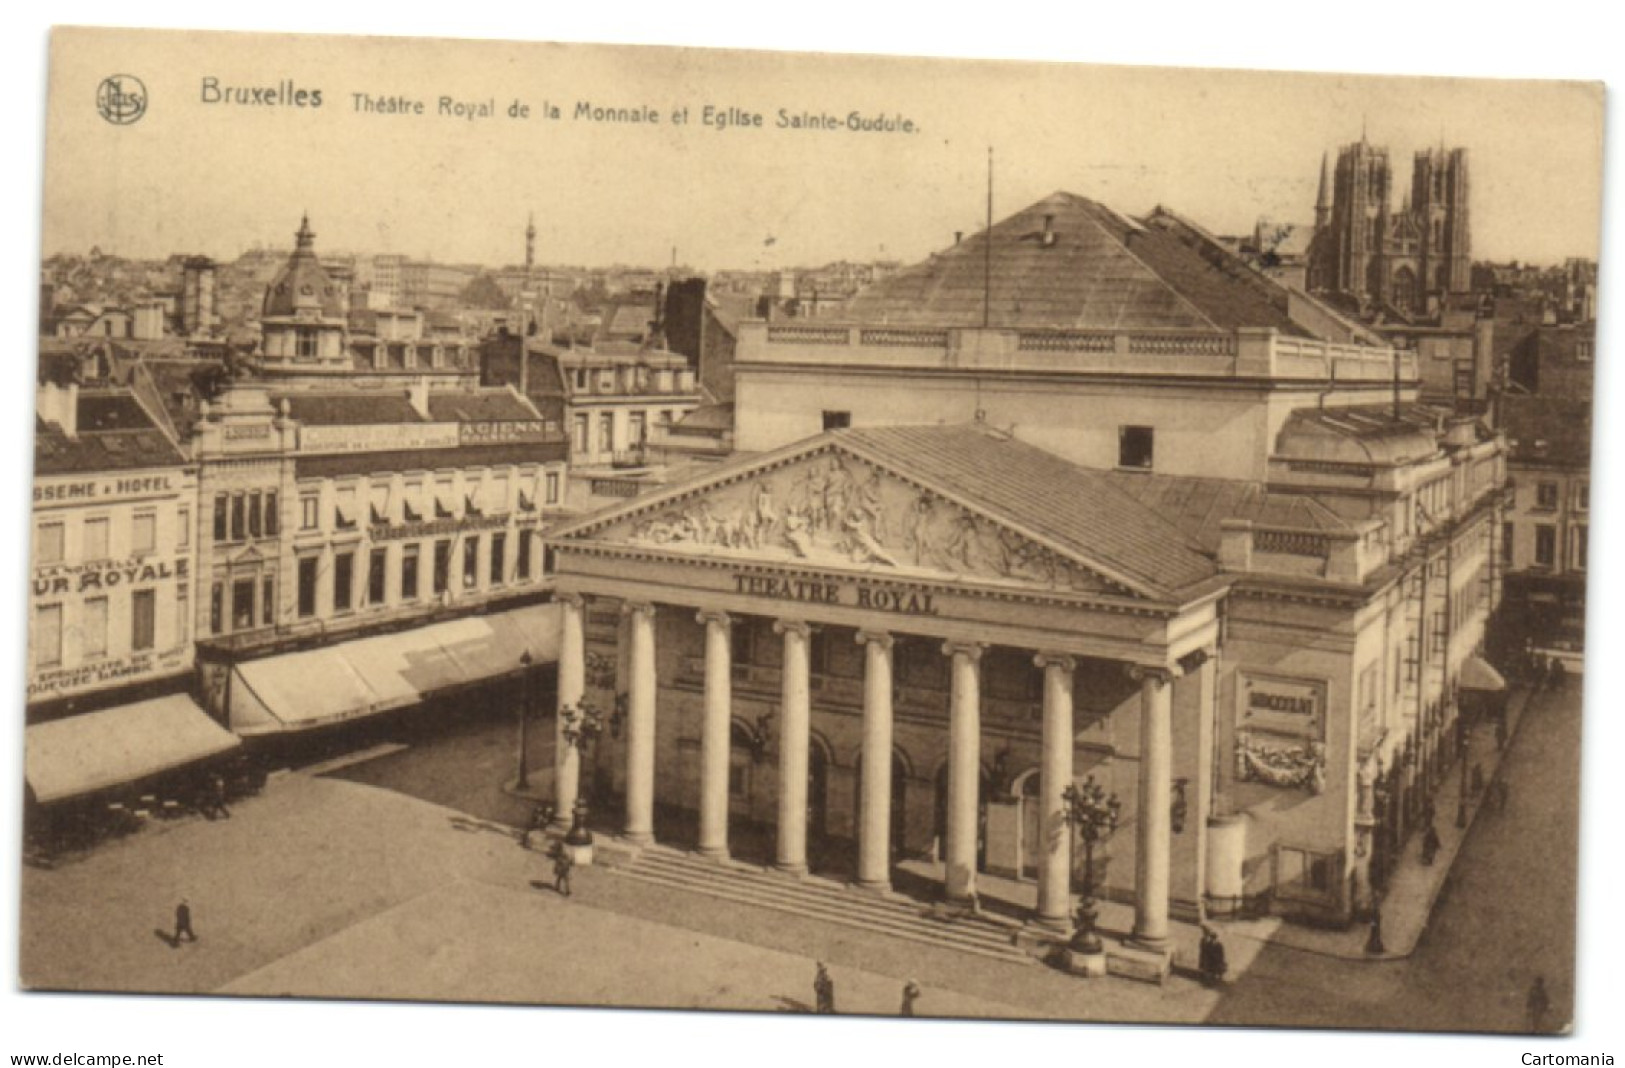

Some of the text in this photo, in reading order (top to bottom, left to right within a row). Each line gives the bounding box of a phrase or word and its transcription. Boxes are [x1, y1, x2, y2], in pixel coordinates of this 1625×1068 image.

[201, 76, 323, 107] Bruxelles
[352, 93, 425, 115] Théâtre
[438, 96, 495, 121] Royal
[507, 99, 530, 119] de
[543, 101, 561, 120] la
[573, 102, 659, 123] Monnaie
[671, 107, 689, 125] et
[702, 105, 763, 131] Eglise
[116, 477, 173, 494] HOTEL
[77, 558, 189, 593] ROYALE
[732, 574, 939, 616] THEATRE ROYAL
